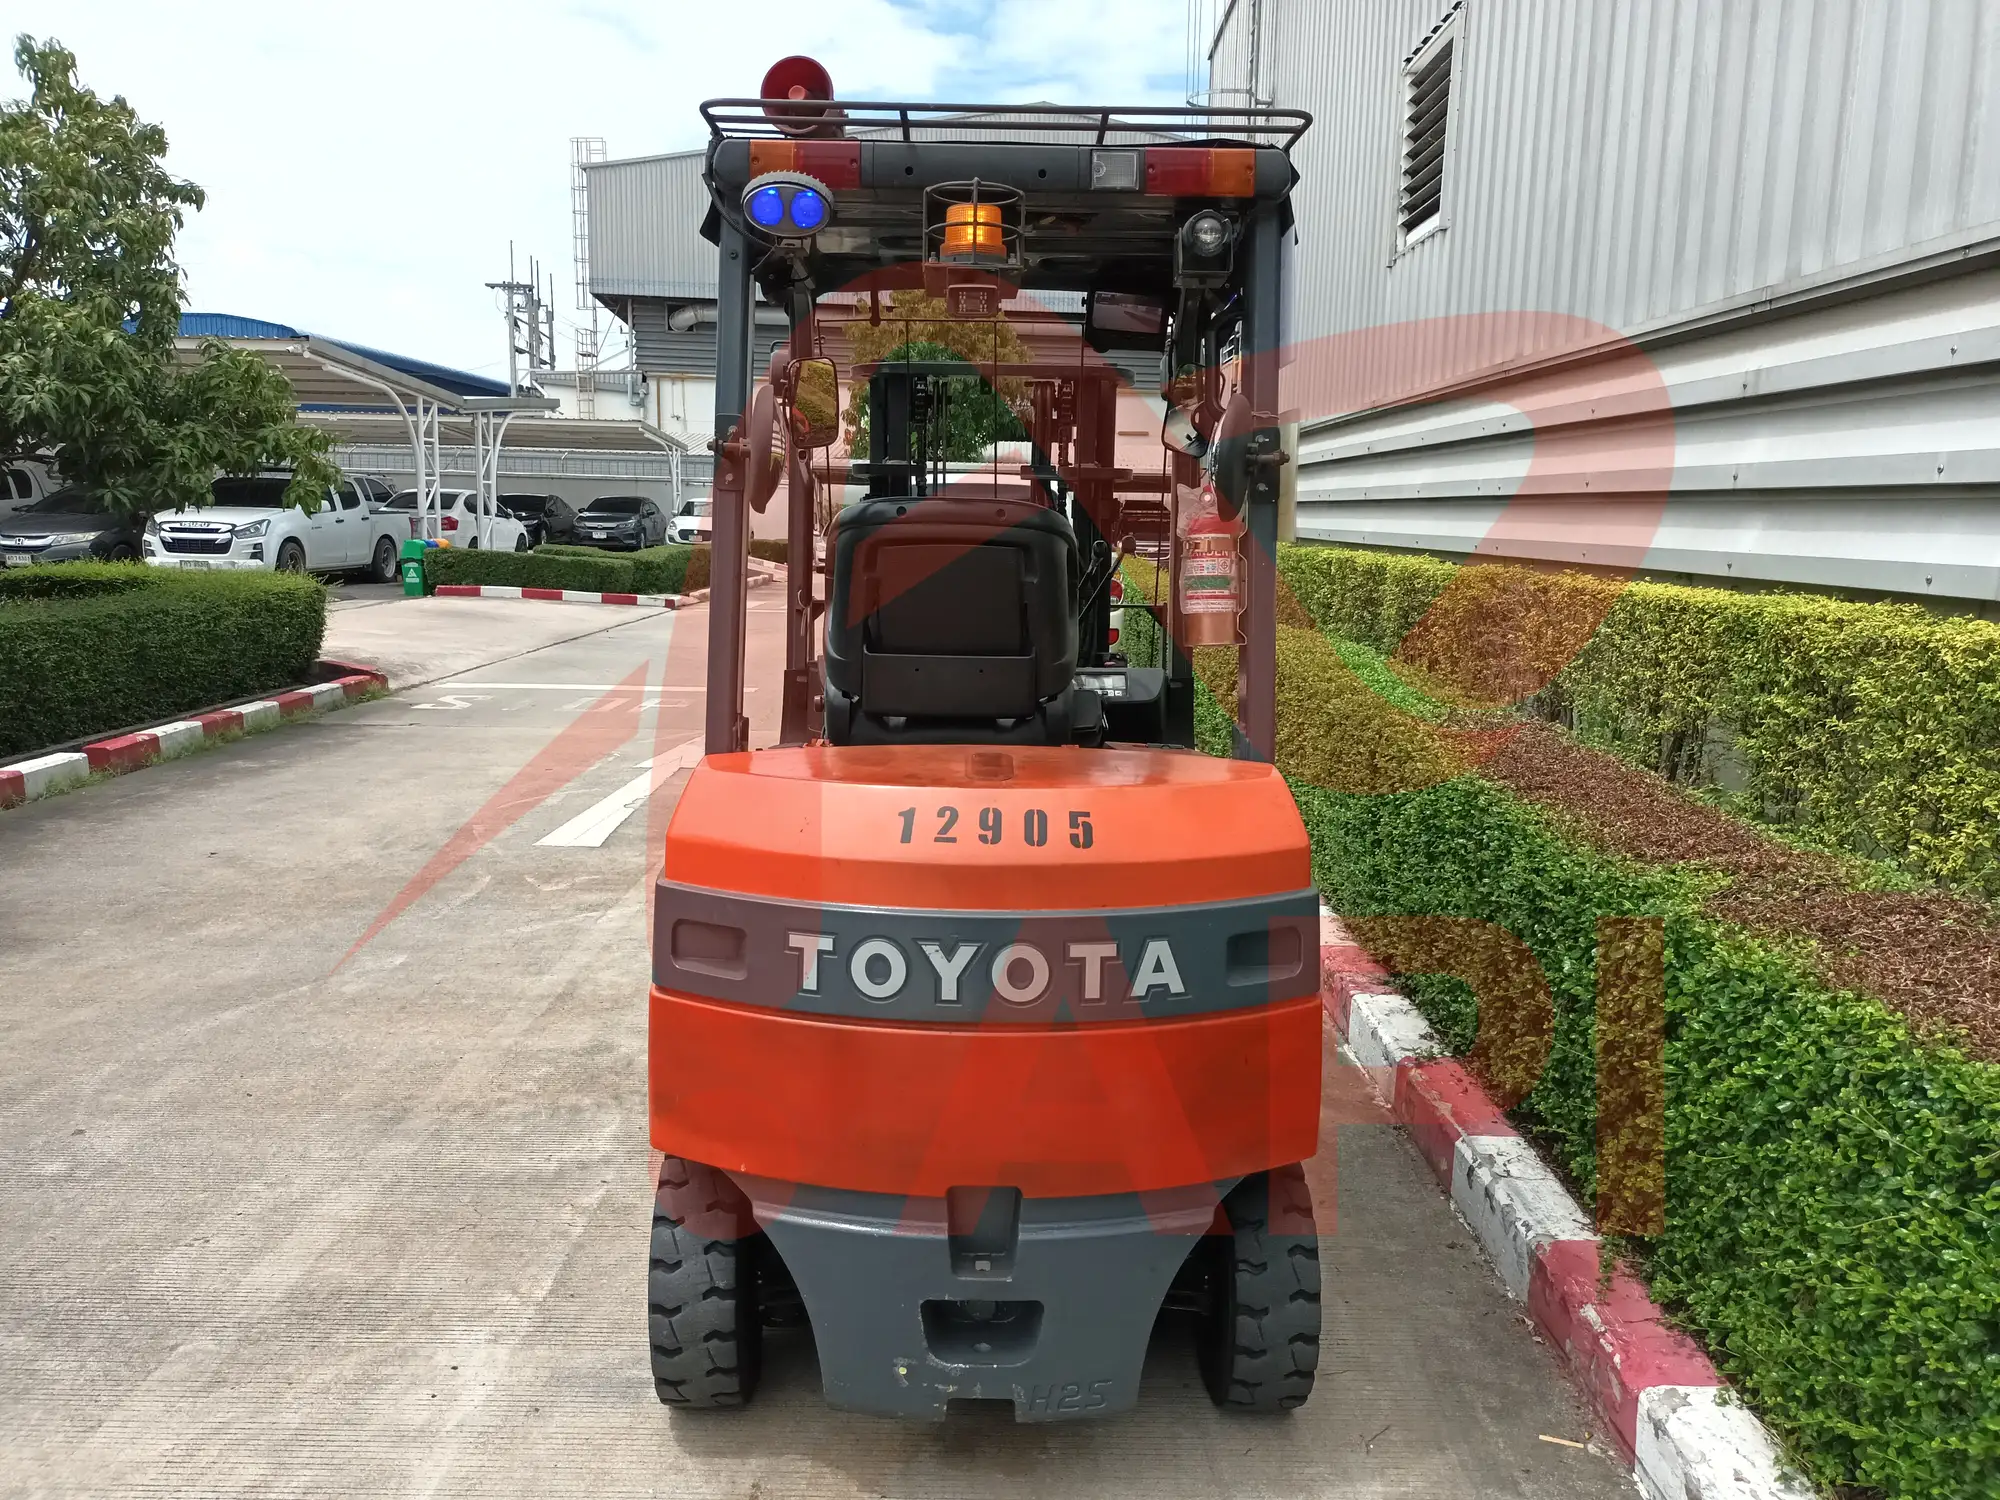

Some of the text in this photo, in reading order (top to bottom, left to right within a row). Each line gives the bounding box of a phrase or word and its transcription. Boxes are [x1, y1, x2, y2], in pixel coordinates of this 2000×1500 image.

[182, 521, 208, 529] ISUZU
[410, 694, 692, 712] SOP
[898, 806, 1094, 849] 12905
[787, 932, 1188, 1002] TOYOTA
